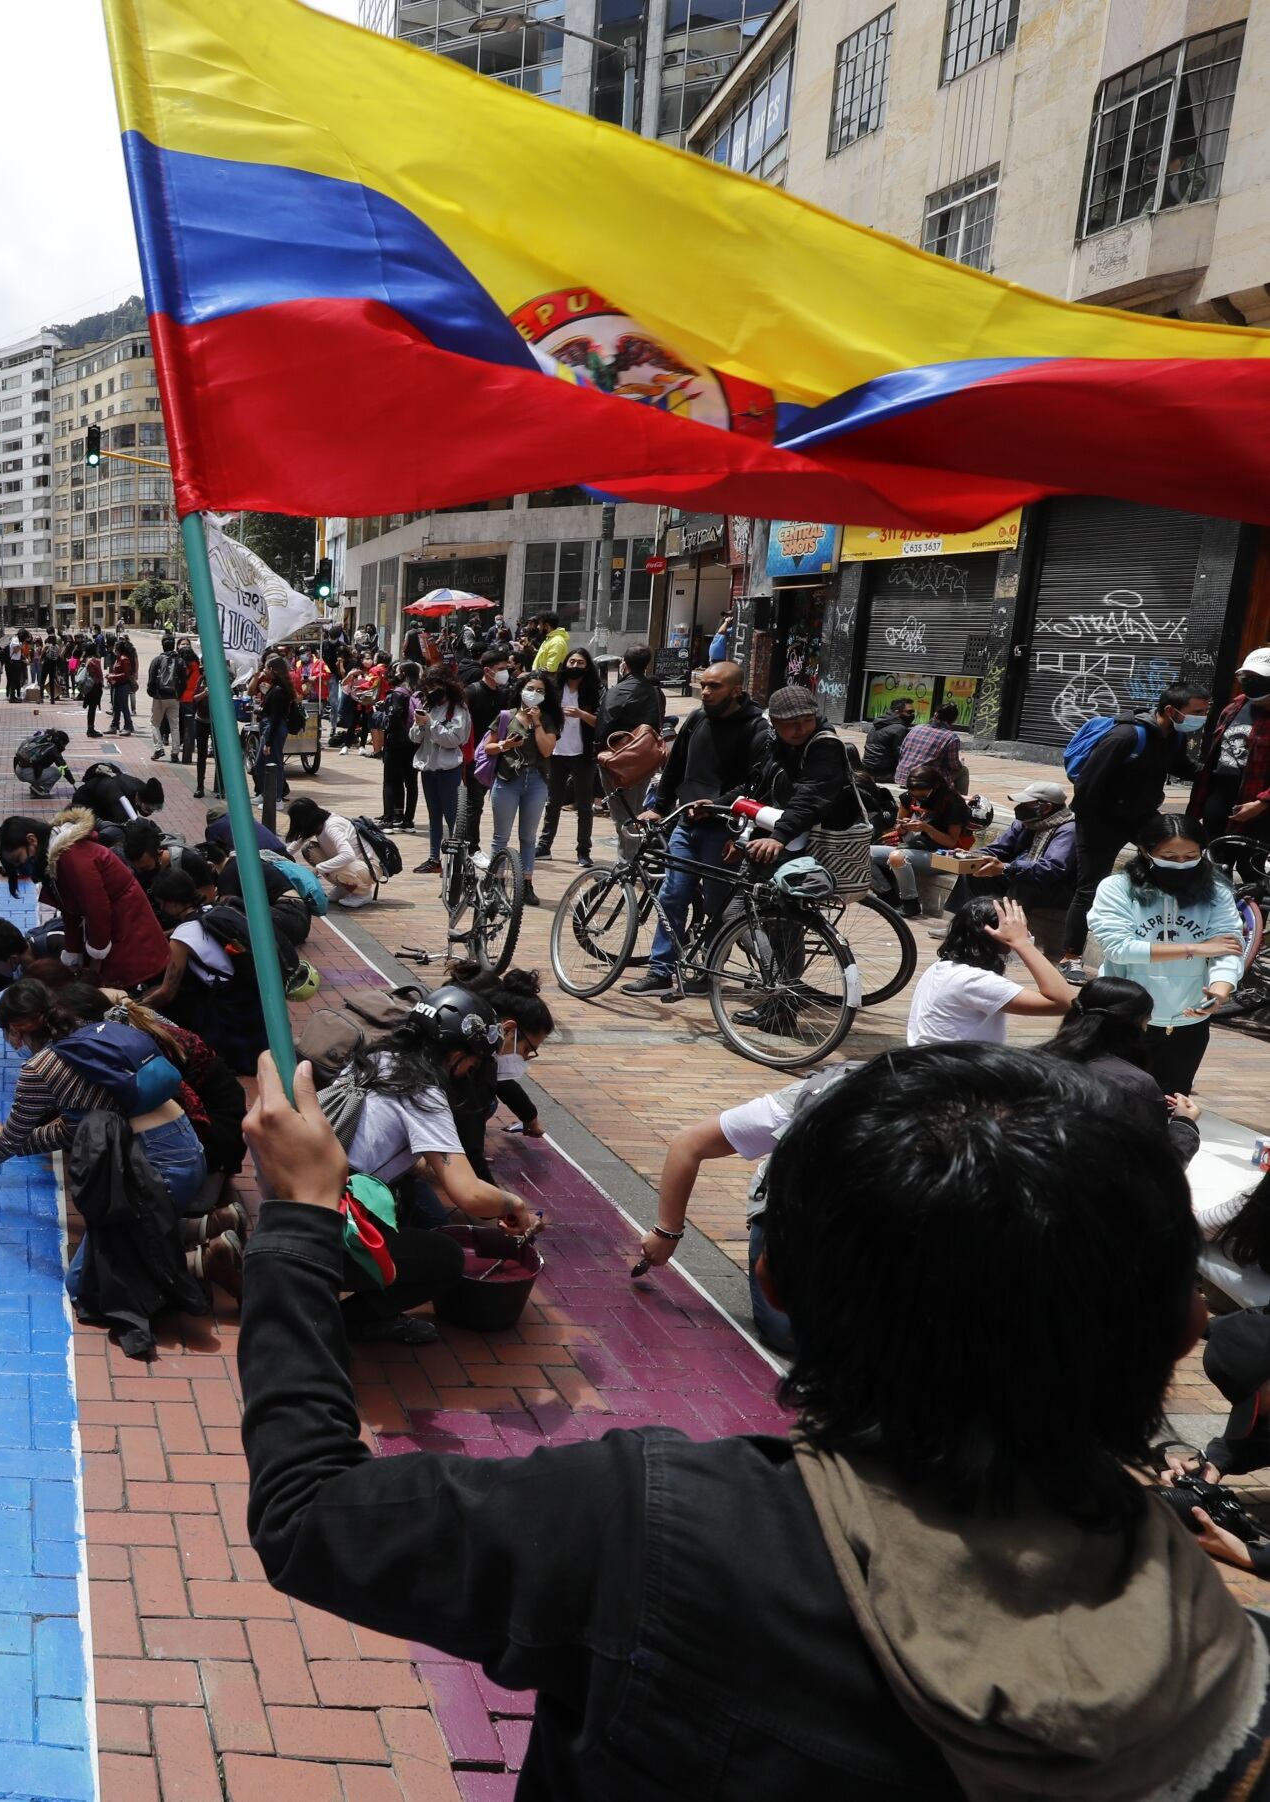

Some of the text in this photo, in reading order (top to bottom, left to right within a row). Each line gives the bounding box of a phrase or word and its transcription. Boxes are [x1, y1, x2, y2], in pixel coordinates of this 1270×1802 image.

[783, 539, 816, 555] SHOTS
[910, 543, 941, 553] 635 3637
